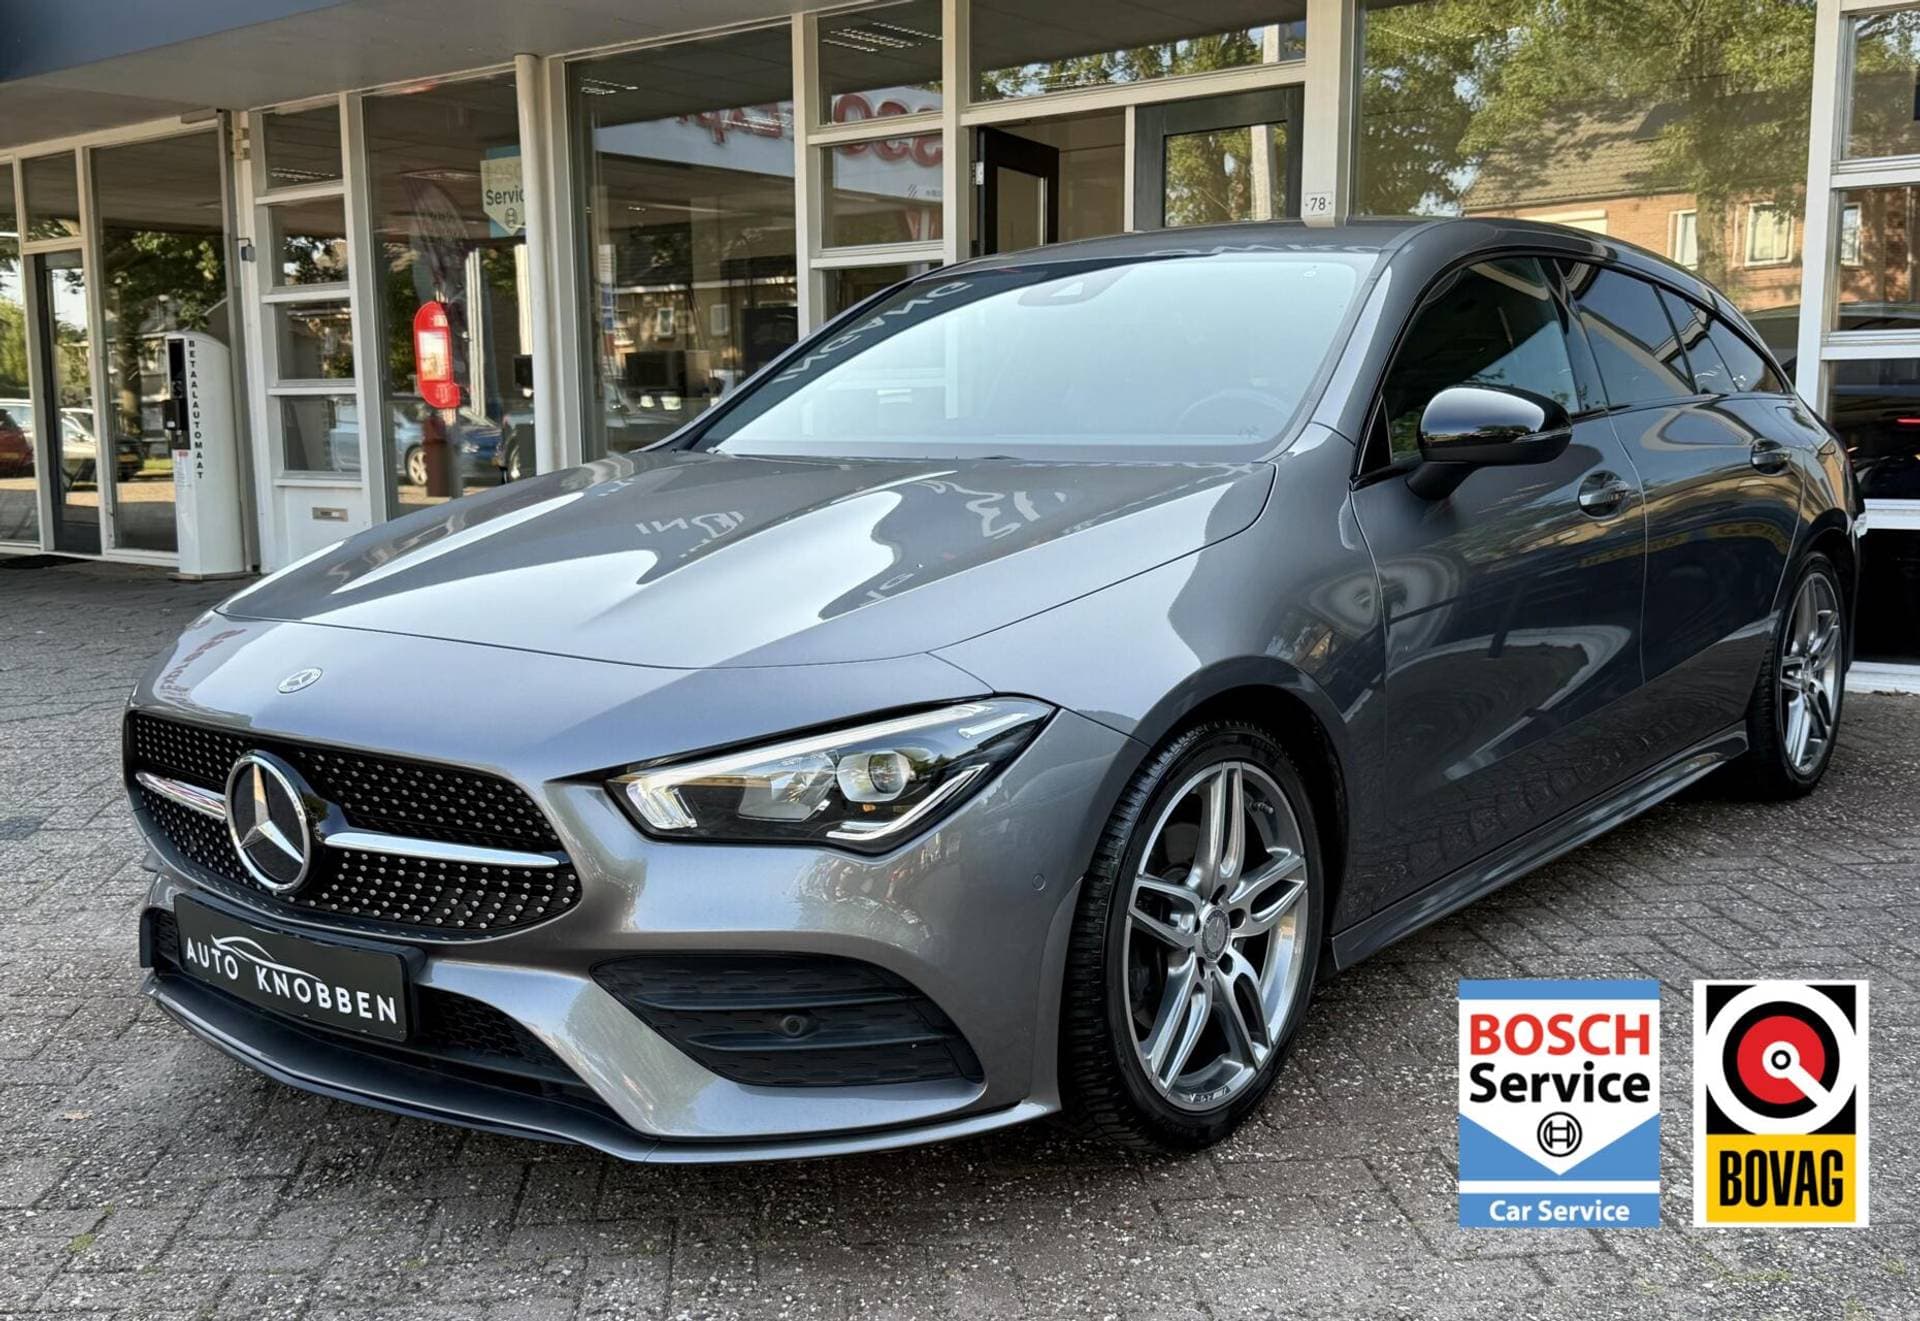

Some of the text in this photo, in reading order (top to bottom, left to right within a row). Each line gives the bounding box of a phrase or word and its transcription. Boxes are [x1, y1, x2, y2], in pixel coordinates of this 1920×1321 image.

[486, 184, 525, 206] Servic
[1310, 196, 1326, 211] 78
[188, 340, 205, 479] BETAALAUTOMAAT
[186, 936, 398, 1025] AUTO KNOBBEN
